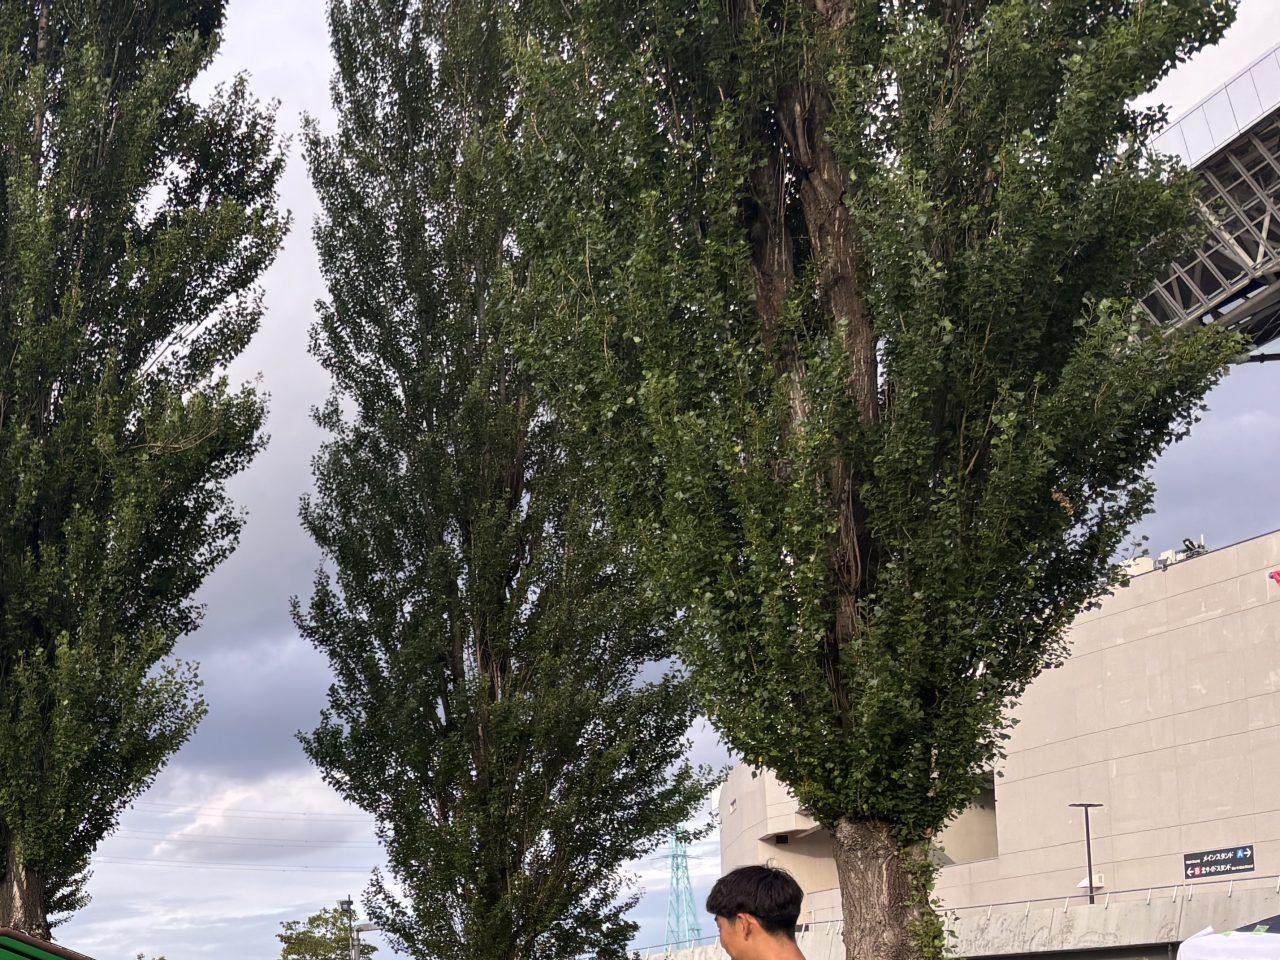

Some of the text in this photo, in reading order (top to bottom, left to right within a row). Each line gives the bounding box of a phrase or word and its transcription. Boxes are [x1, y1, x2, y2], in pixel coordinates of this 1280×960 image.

[1202, 851, 1234, 863] メインスタンド
